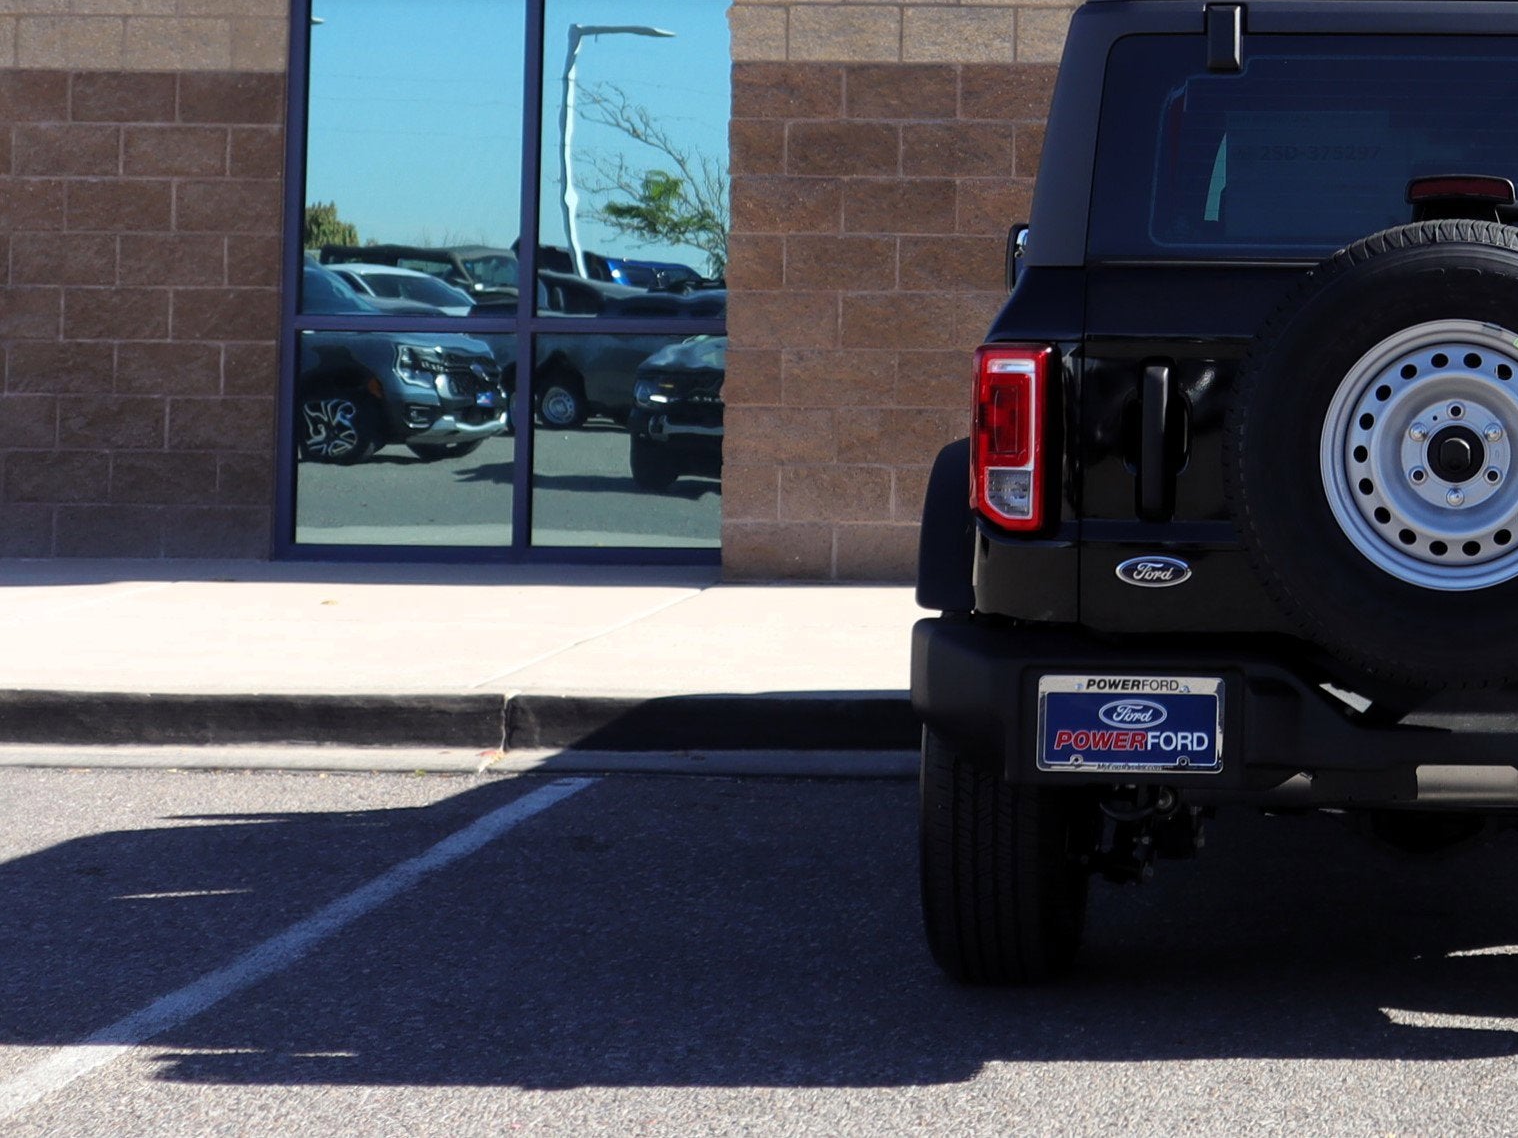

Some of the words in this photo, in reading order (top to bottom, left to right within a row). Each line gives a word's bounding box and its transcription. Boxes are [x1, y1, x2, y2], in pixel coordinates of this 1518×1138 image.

[1132, 562, 1174, 581] Ford
[1112, 704, 1153, 723] Ford
[1053, 730, 1209, 752] POWERFORD
